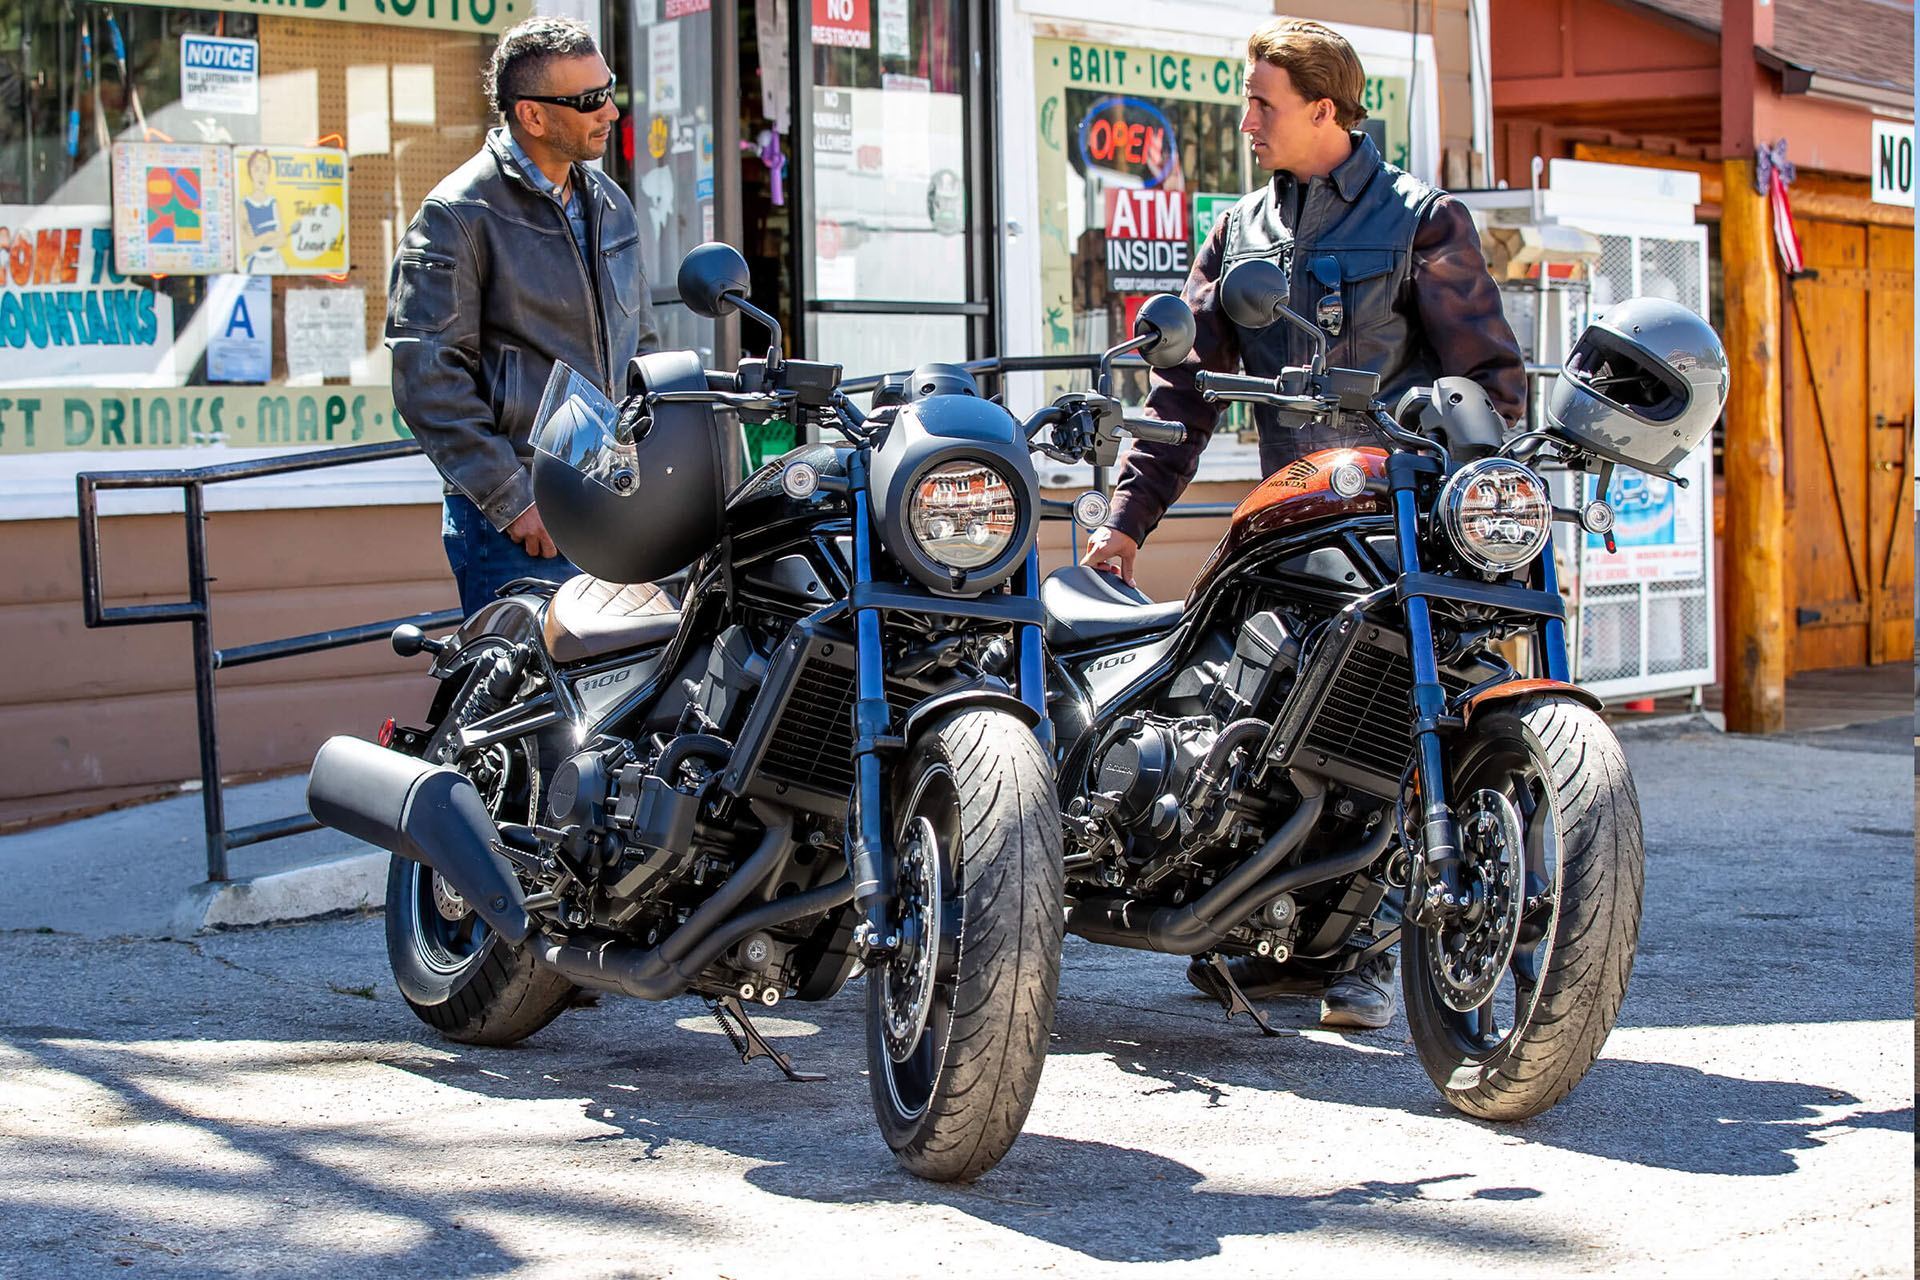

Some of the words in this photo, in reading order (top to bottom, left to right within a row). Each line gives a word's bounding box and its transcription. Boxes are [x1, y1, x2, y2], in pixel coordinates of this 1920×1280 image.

[827, 0, 854, 22] NO
[187, 43, 253, 69] NOTICE
[812, 26, 870, 48] RESTROOM
[1069, 46, 1126, 85] BAIT
[1151, 54, 1191, 91] ICE
[1089, 119, 1164, 165] OPEN
[1880, 134, 1911, 193] NO
[1111, 190, 1183, 240] ATM
[1107, 240, 1188, 272] INSIDE
[0, 288, 157, 349] OUNTAINS
[225, 294, 255, 338] A
[64, 396, 224, 446] DRINKS
[257, 394, 366, 443] MAPS
[1267, 480, 1308, 490] HONDA
[582, 669, 630, 691] 1100
